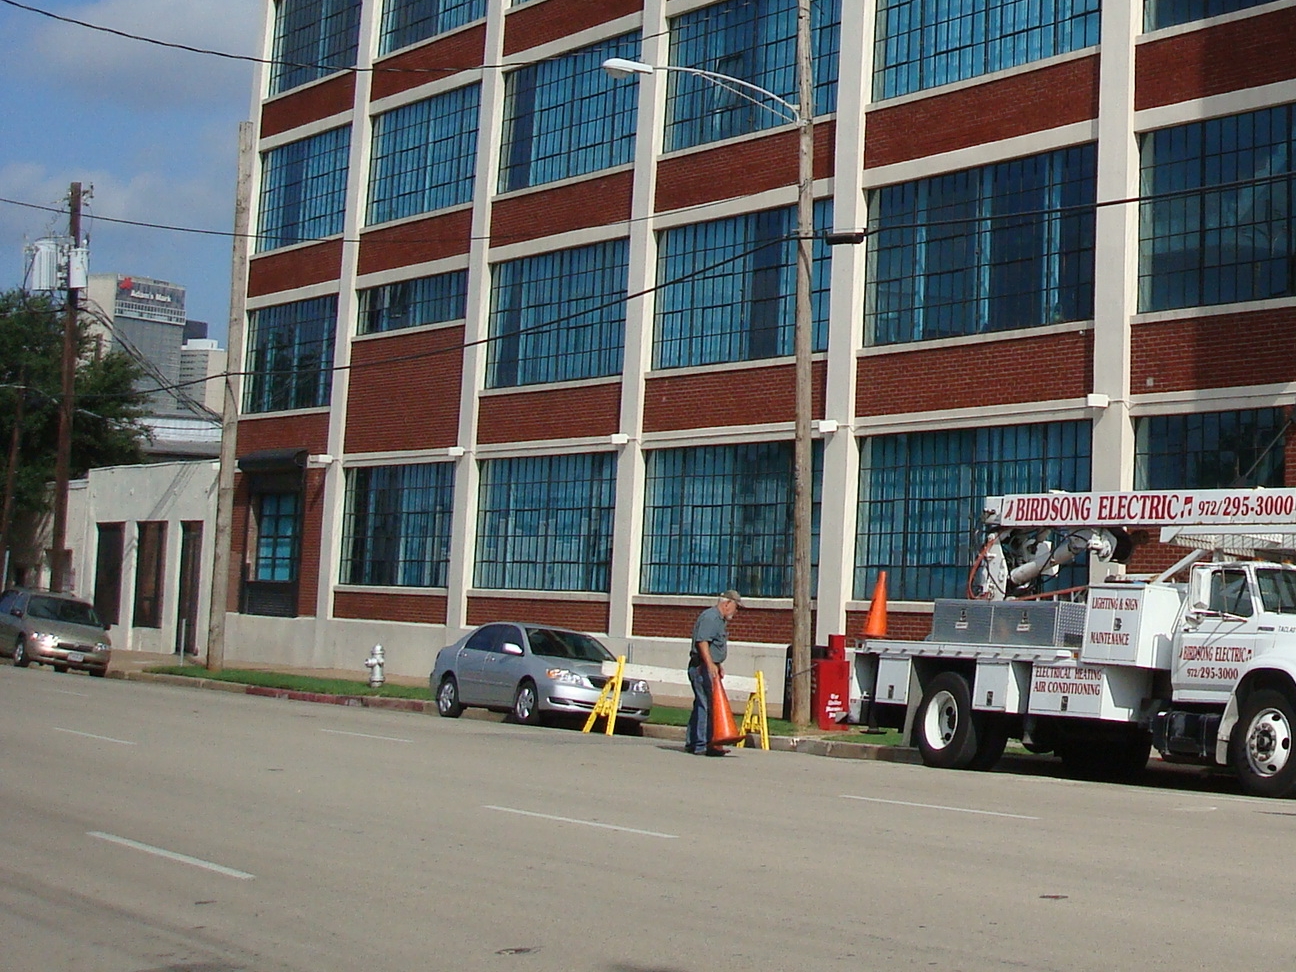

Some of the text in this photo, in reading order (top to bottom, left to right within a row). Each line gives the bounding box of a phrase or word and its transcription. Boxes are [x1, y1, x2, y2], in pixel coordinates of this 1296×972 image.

[1015, 496, 1092, 522] BIRDSONG
[1097, 494, 1179, 521] ELECTRIC
[1183, 645, 1247, 663] BIRDSONG ELECTRIC
[1034, 681, 1047, 693] AIR
